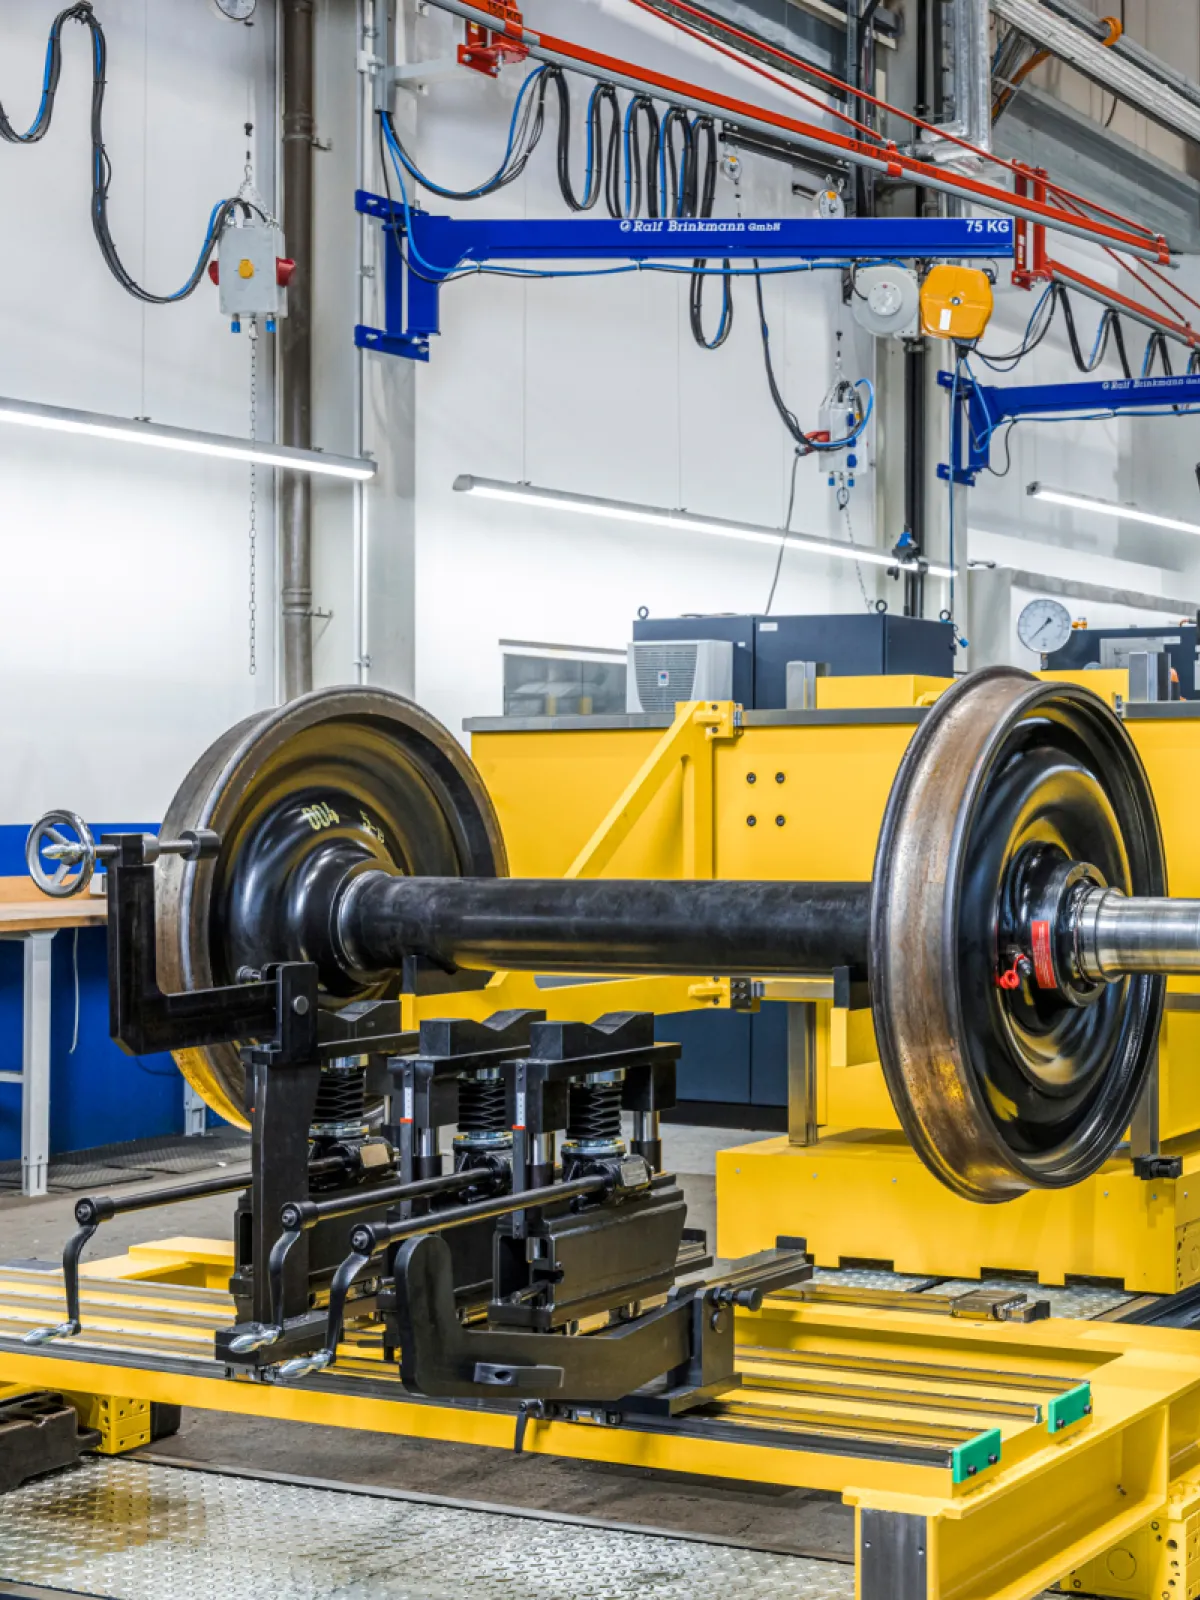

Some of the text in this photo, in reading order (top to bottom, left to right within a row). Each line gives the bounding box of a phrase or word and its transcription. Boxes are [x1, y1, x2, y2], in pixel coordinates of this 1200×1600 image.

[633, 221, 664, 232] Ralf
[667, 220, 745, 232] Brinkmann
[966, 220, 1010, 232] 75 KG
